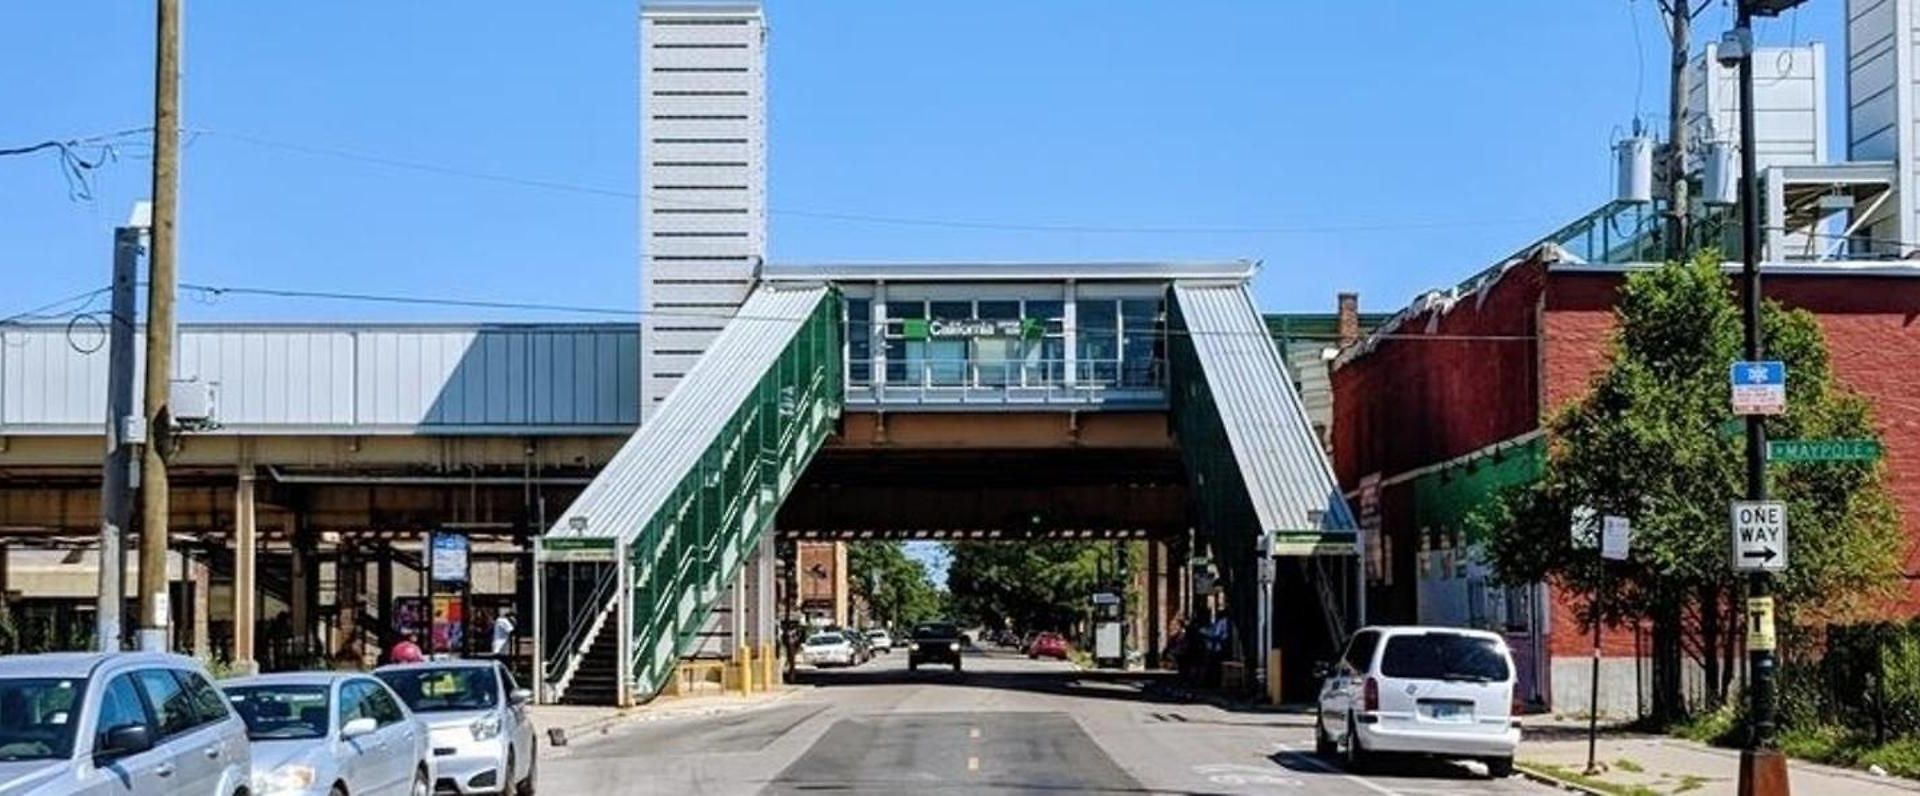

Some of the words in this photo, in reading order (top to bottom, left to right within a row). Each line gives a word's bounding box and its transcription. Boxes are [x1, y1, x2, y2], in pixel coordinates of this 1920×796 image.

[930, 320, 995, 336] California
[1786, 443, 1864, 459] MAYPOLE
[1740, 508, 1779, 524] ONE
[1739, 526, 1779, 542] WAY
